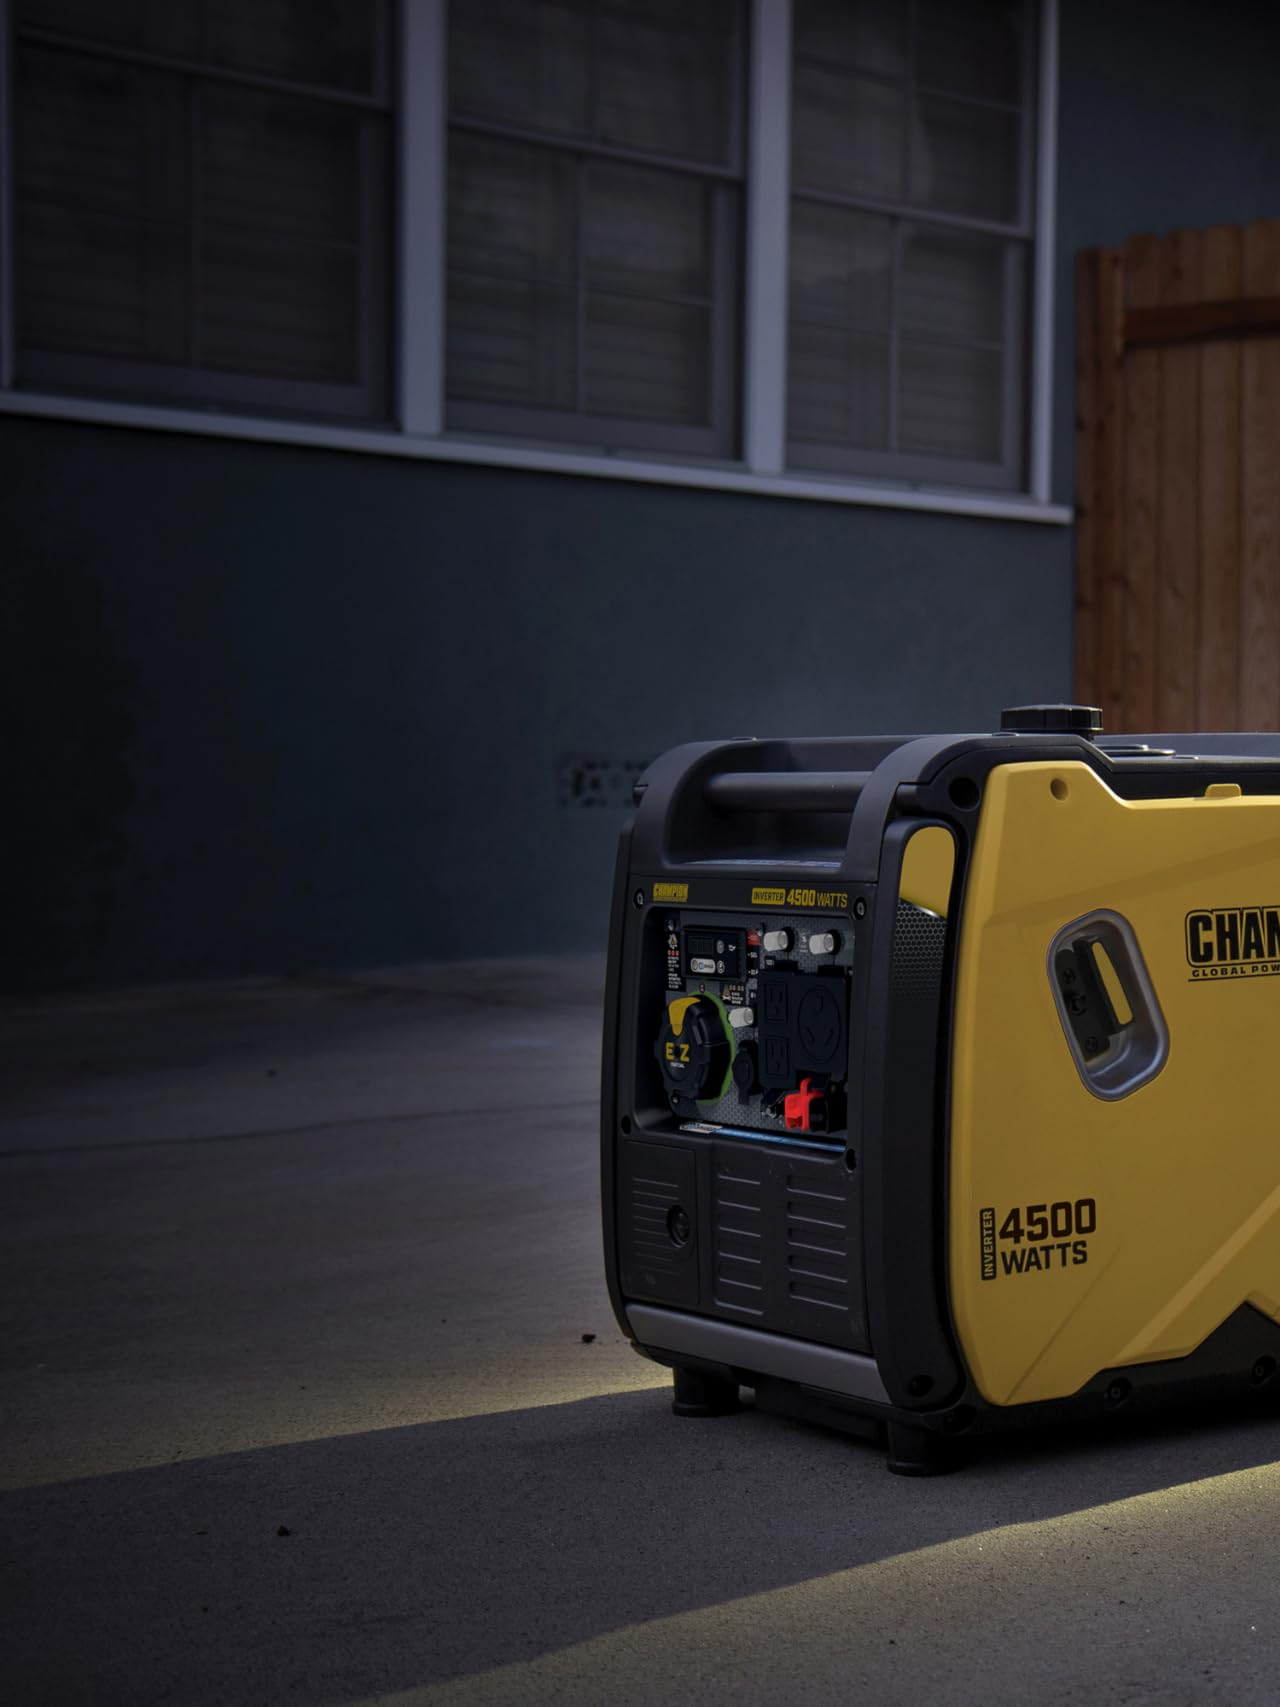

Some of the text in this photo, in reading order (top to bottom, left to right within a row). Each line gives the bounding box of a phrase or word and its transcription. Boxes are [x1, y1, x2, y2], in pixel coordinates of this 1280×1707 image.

[754, 888, 848, 908] INVERTER 4500 WATTS
[1192, 966, 1246, 977] GLOBAL
[999, 1198, 1096, 1244] 4500
[983, 1209, 995, 1278] INVERTER
[1000, 1240, 1088, 1275] WATTS
